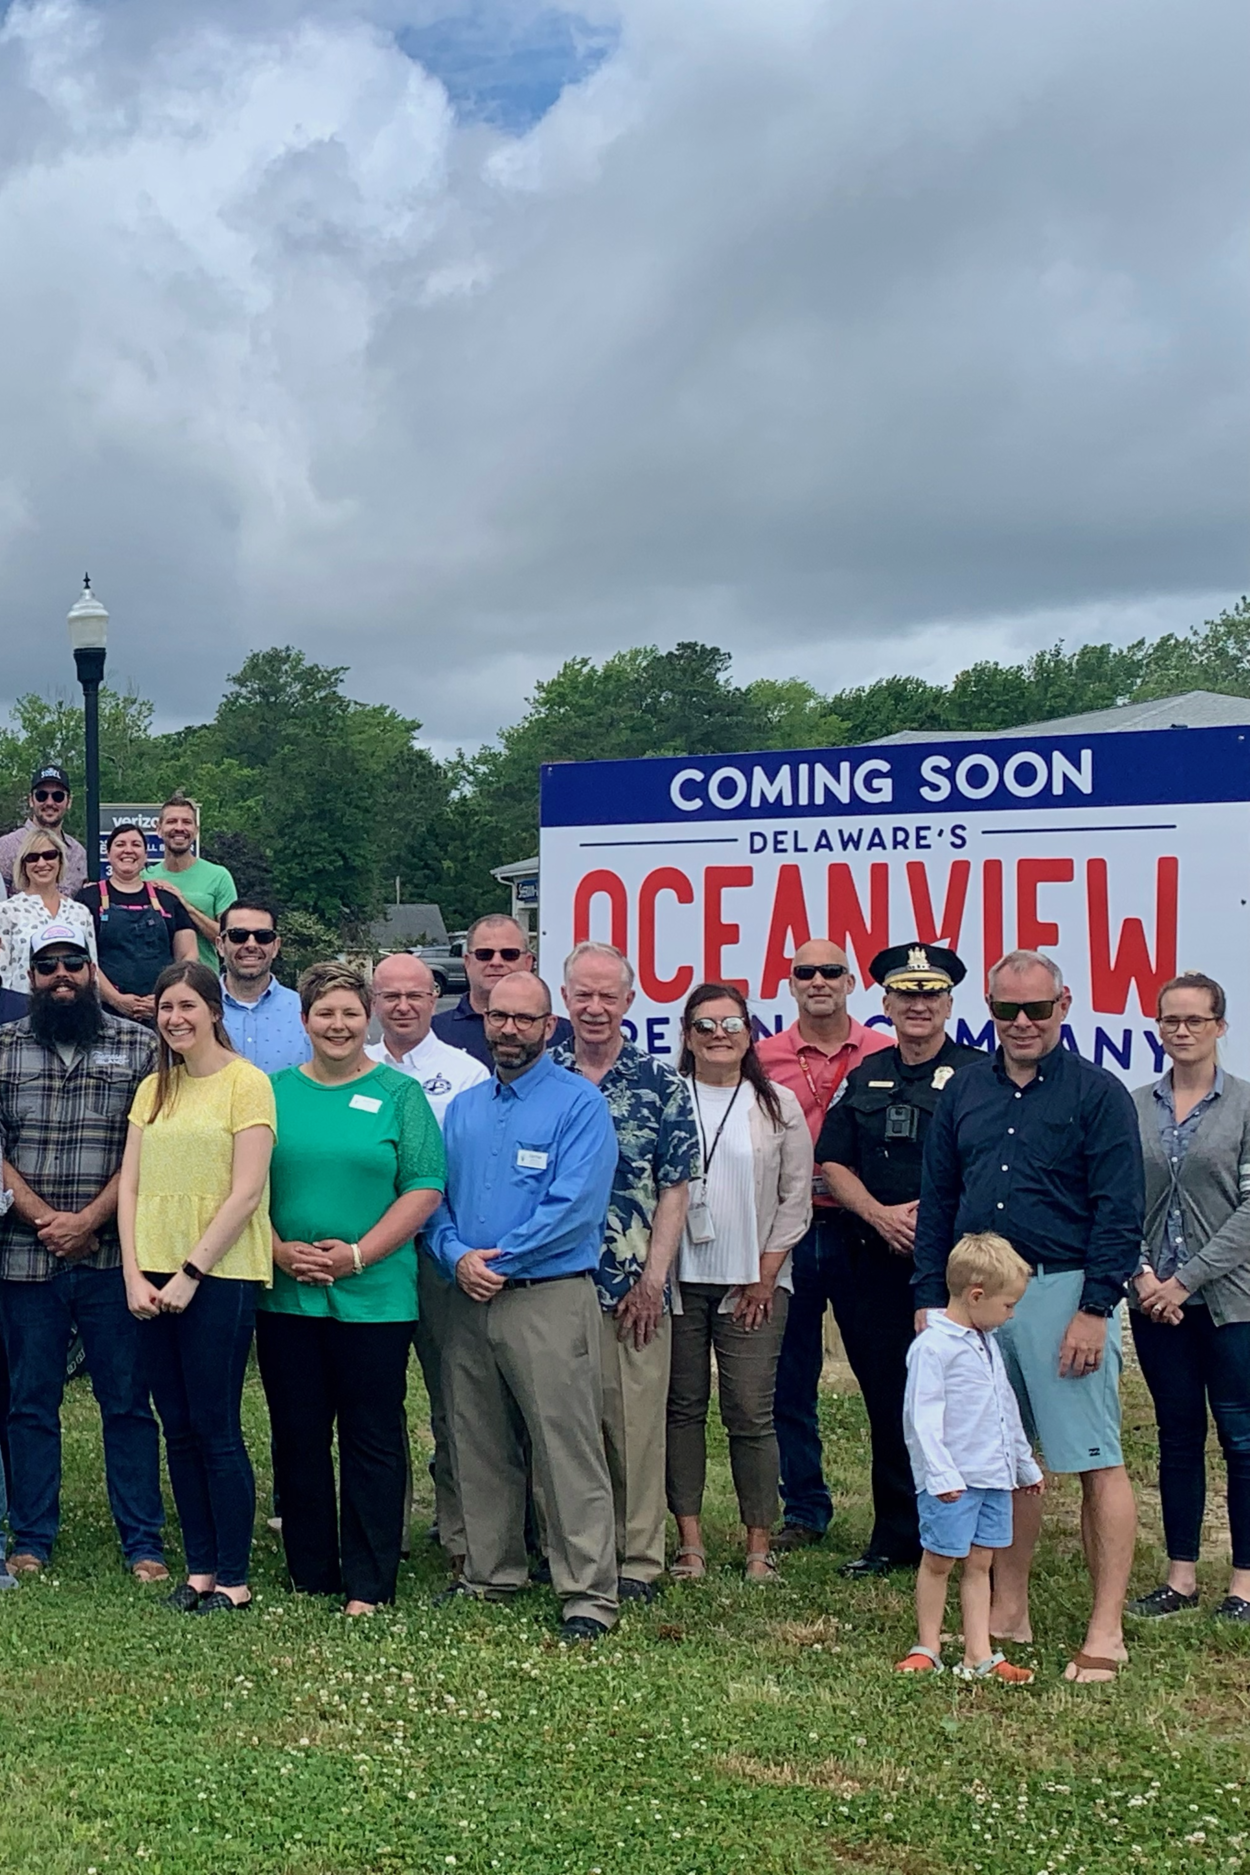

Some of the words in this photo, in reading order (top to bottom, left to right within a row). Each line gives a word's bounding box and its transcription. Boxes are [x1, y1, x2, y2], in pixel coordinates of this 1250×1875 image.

[670, 759, 893, 811] COMING
[919, 748, 1093, 802] SOON
[112, 813, 160, 829] verizo
[749, 823, 969, 855] DELAWARE'S
[573, 856, 1180, 1017] OCEANVIEW
